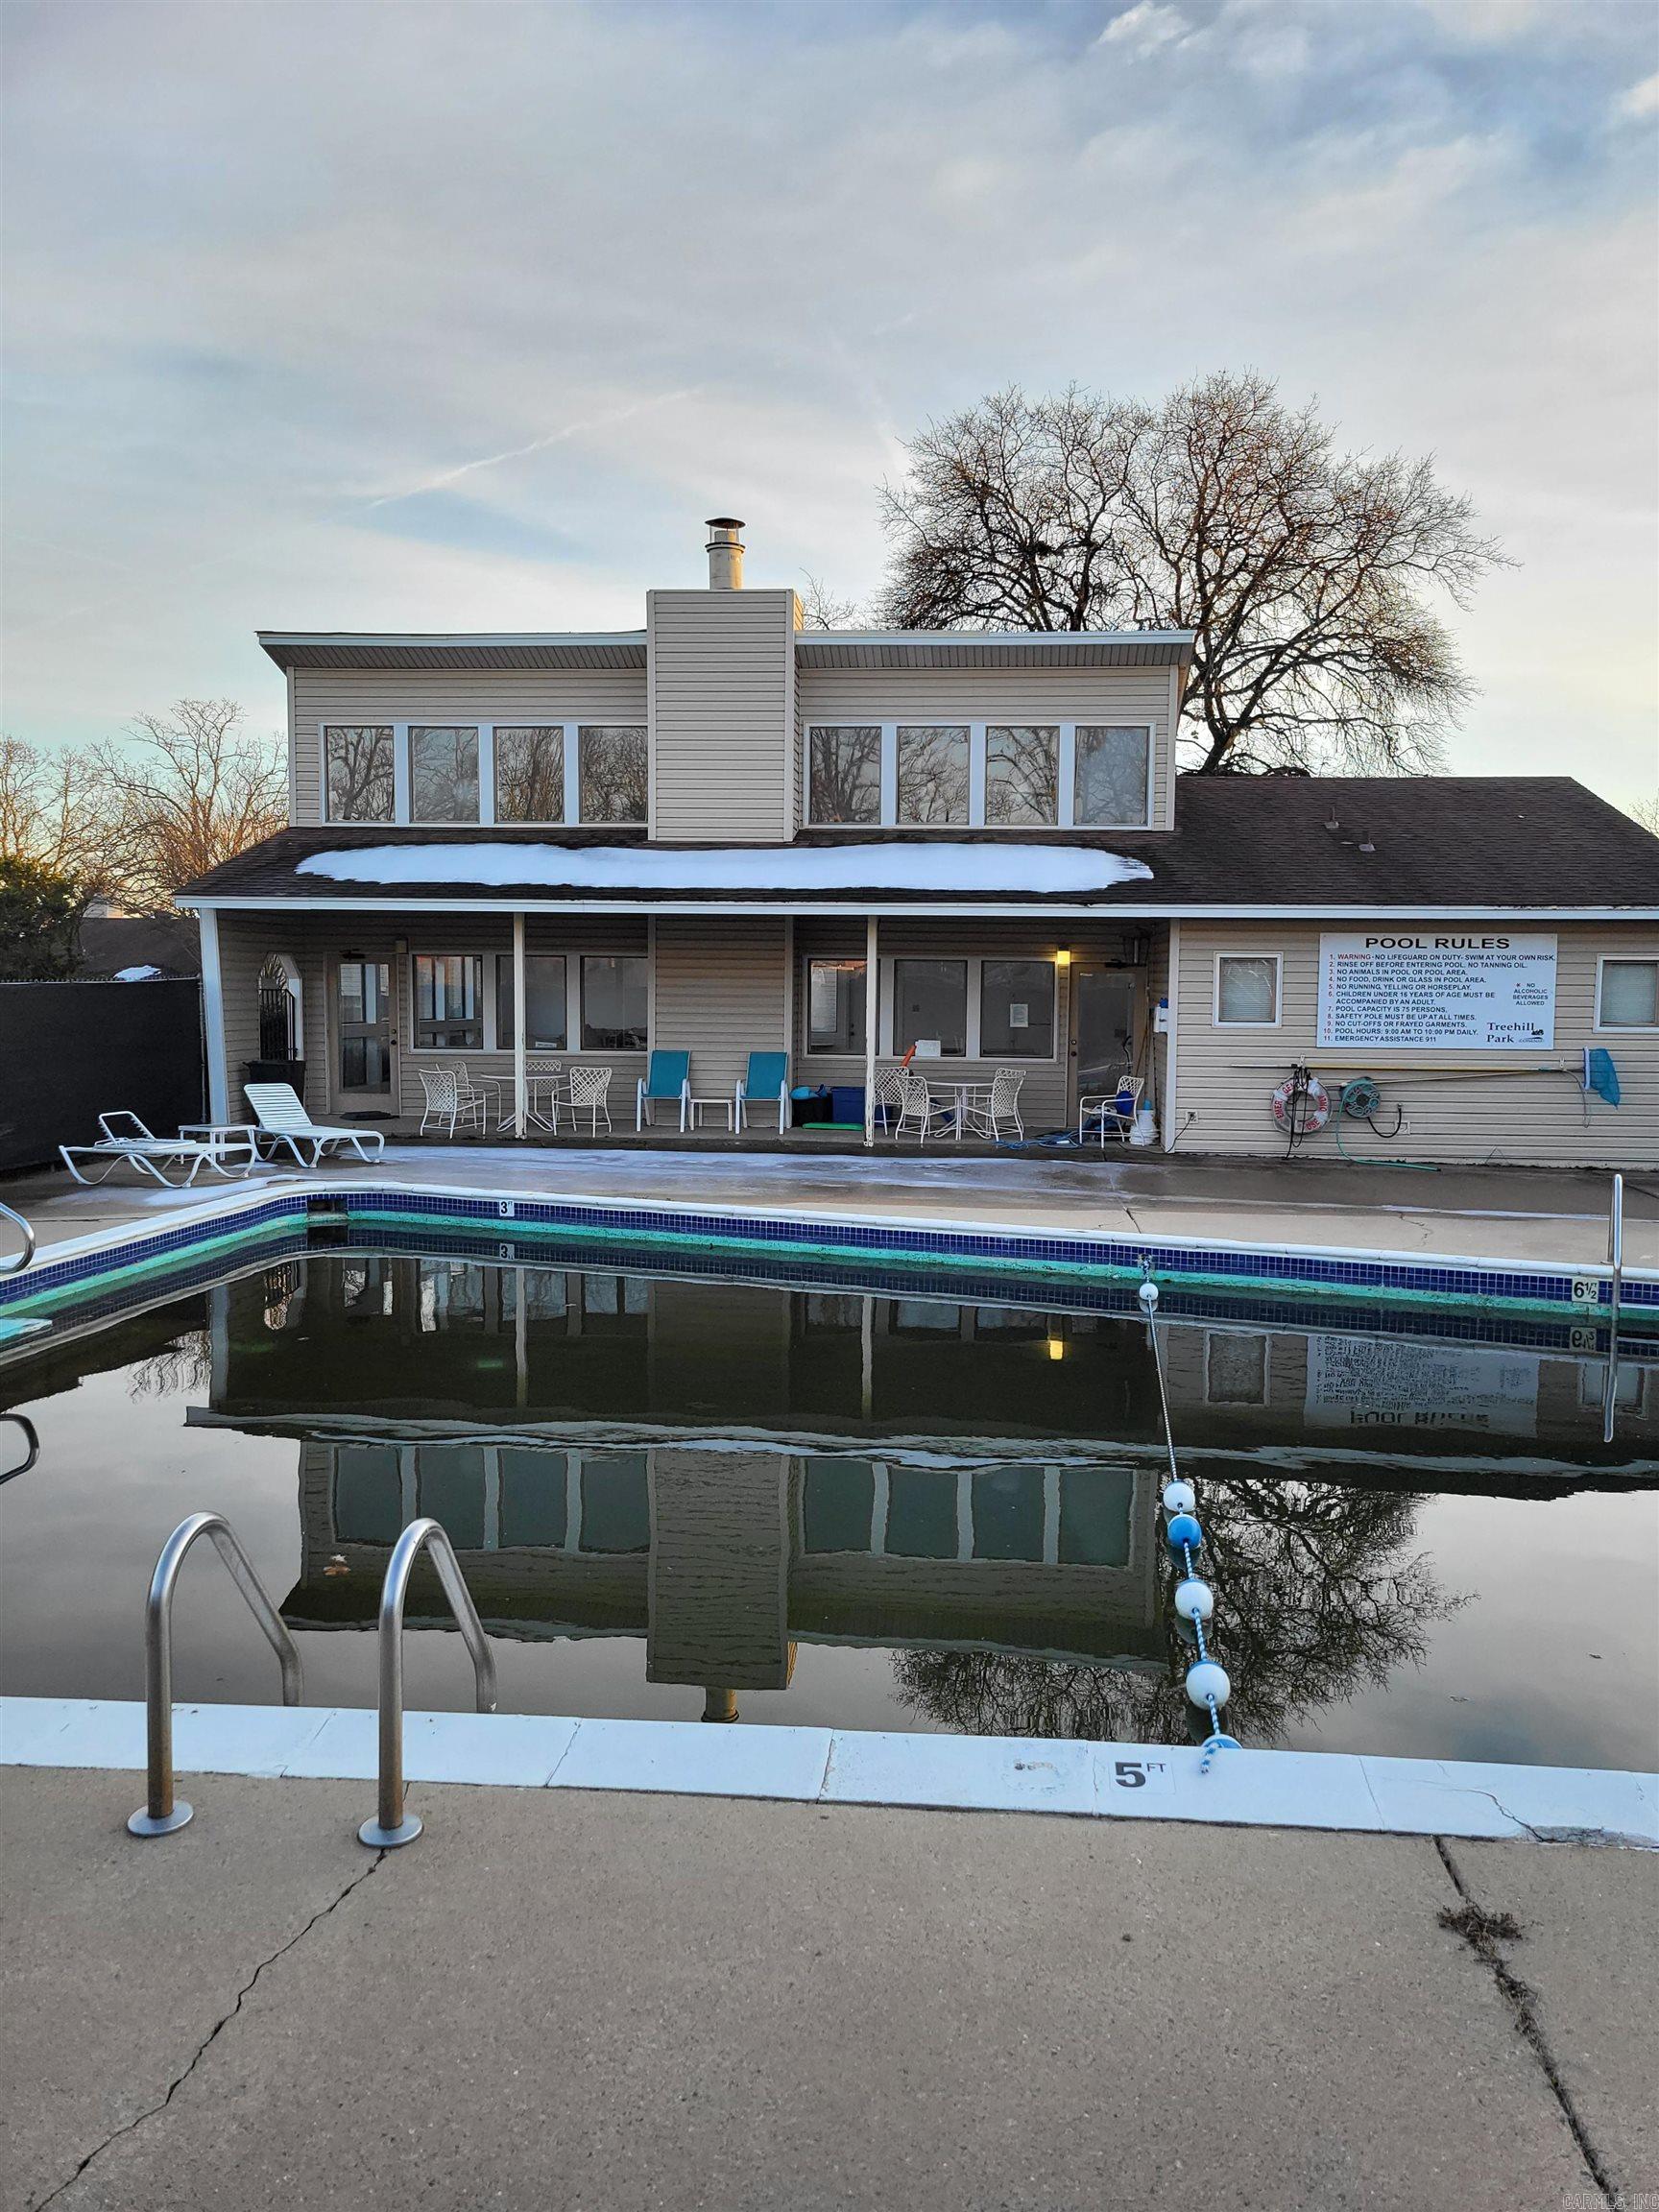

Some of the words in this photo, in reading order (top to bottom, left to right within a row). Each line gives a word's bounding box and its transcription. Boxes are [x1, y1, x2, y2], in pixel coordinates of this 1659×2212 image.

[1365, 937, 1428, 949] POOL
[1434, 938, 1510, 949] RULES
[1486, 1022, 1534, 1031] Treehill
[1487, 1034, 1515, 1043] Park
[500, 1201, 508, 1214] 3
[1115, 1762, 1146, 1788] 5
[1146, 1763, 1166, 1773] FT
